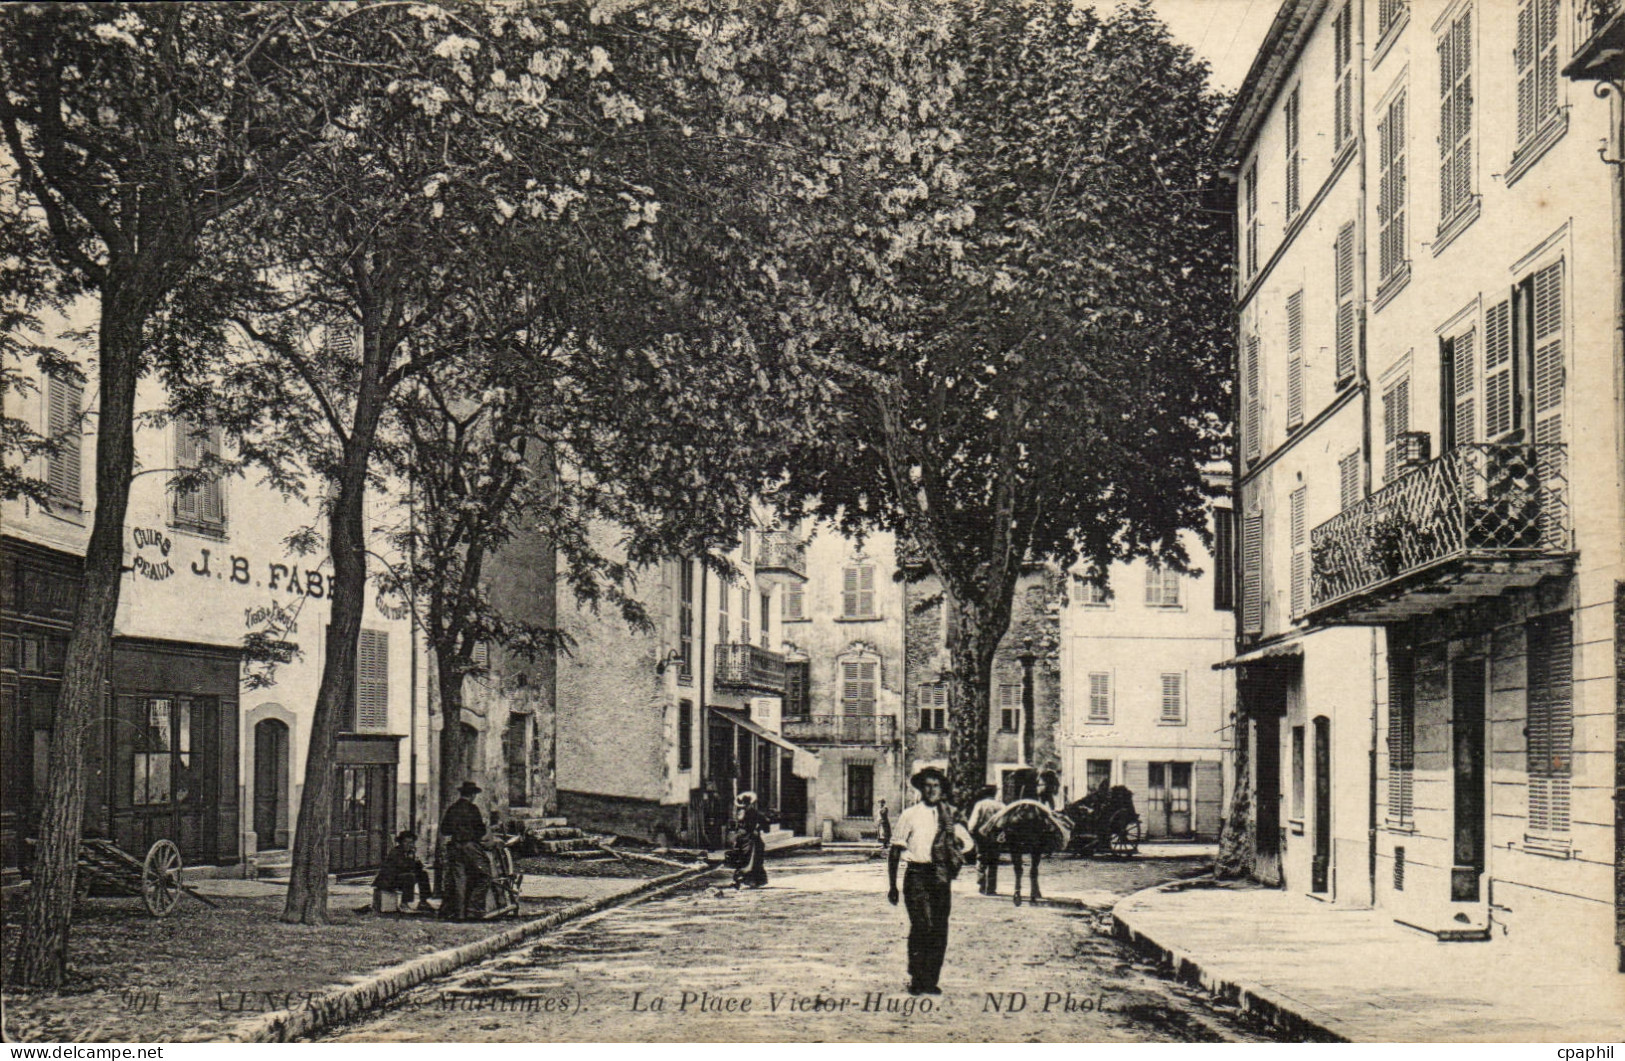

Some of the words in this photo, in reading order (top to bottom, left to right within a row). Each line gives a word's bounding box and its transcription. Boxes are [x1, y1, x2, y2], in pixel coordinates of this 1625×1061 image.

[134, 553, 175, 581] PEAUX
[191, 548, 223, 580] J.
[230, 555, 262, 587] B.
